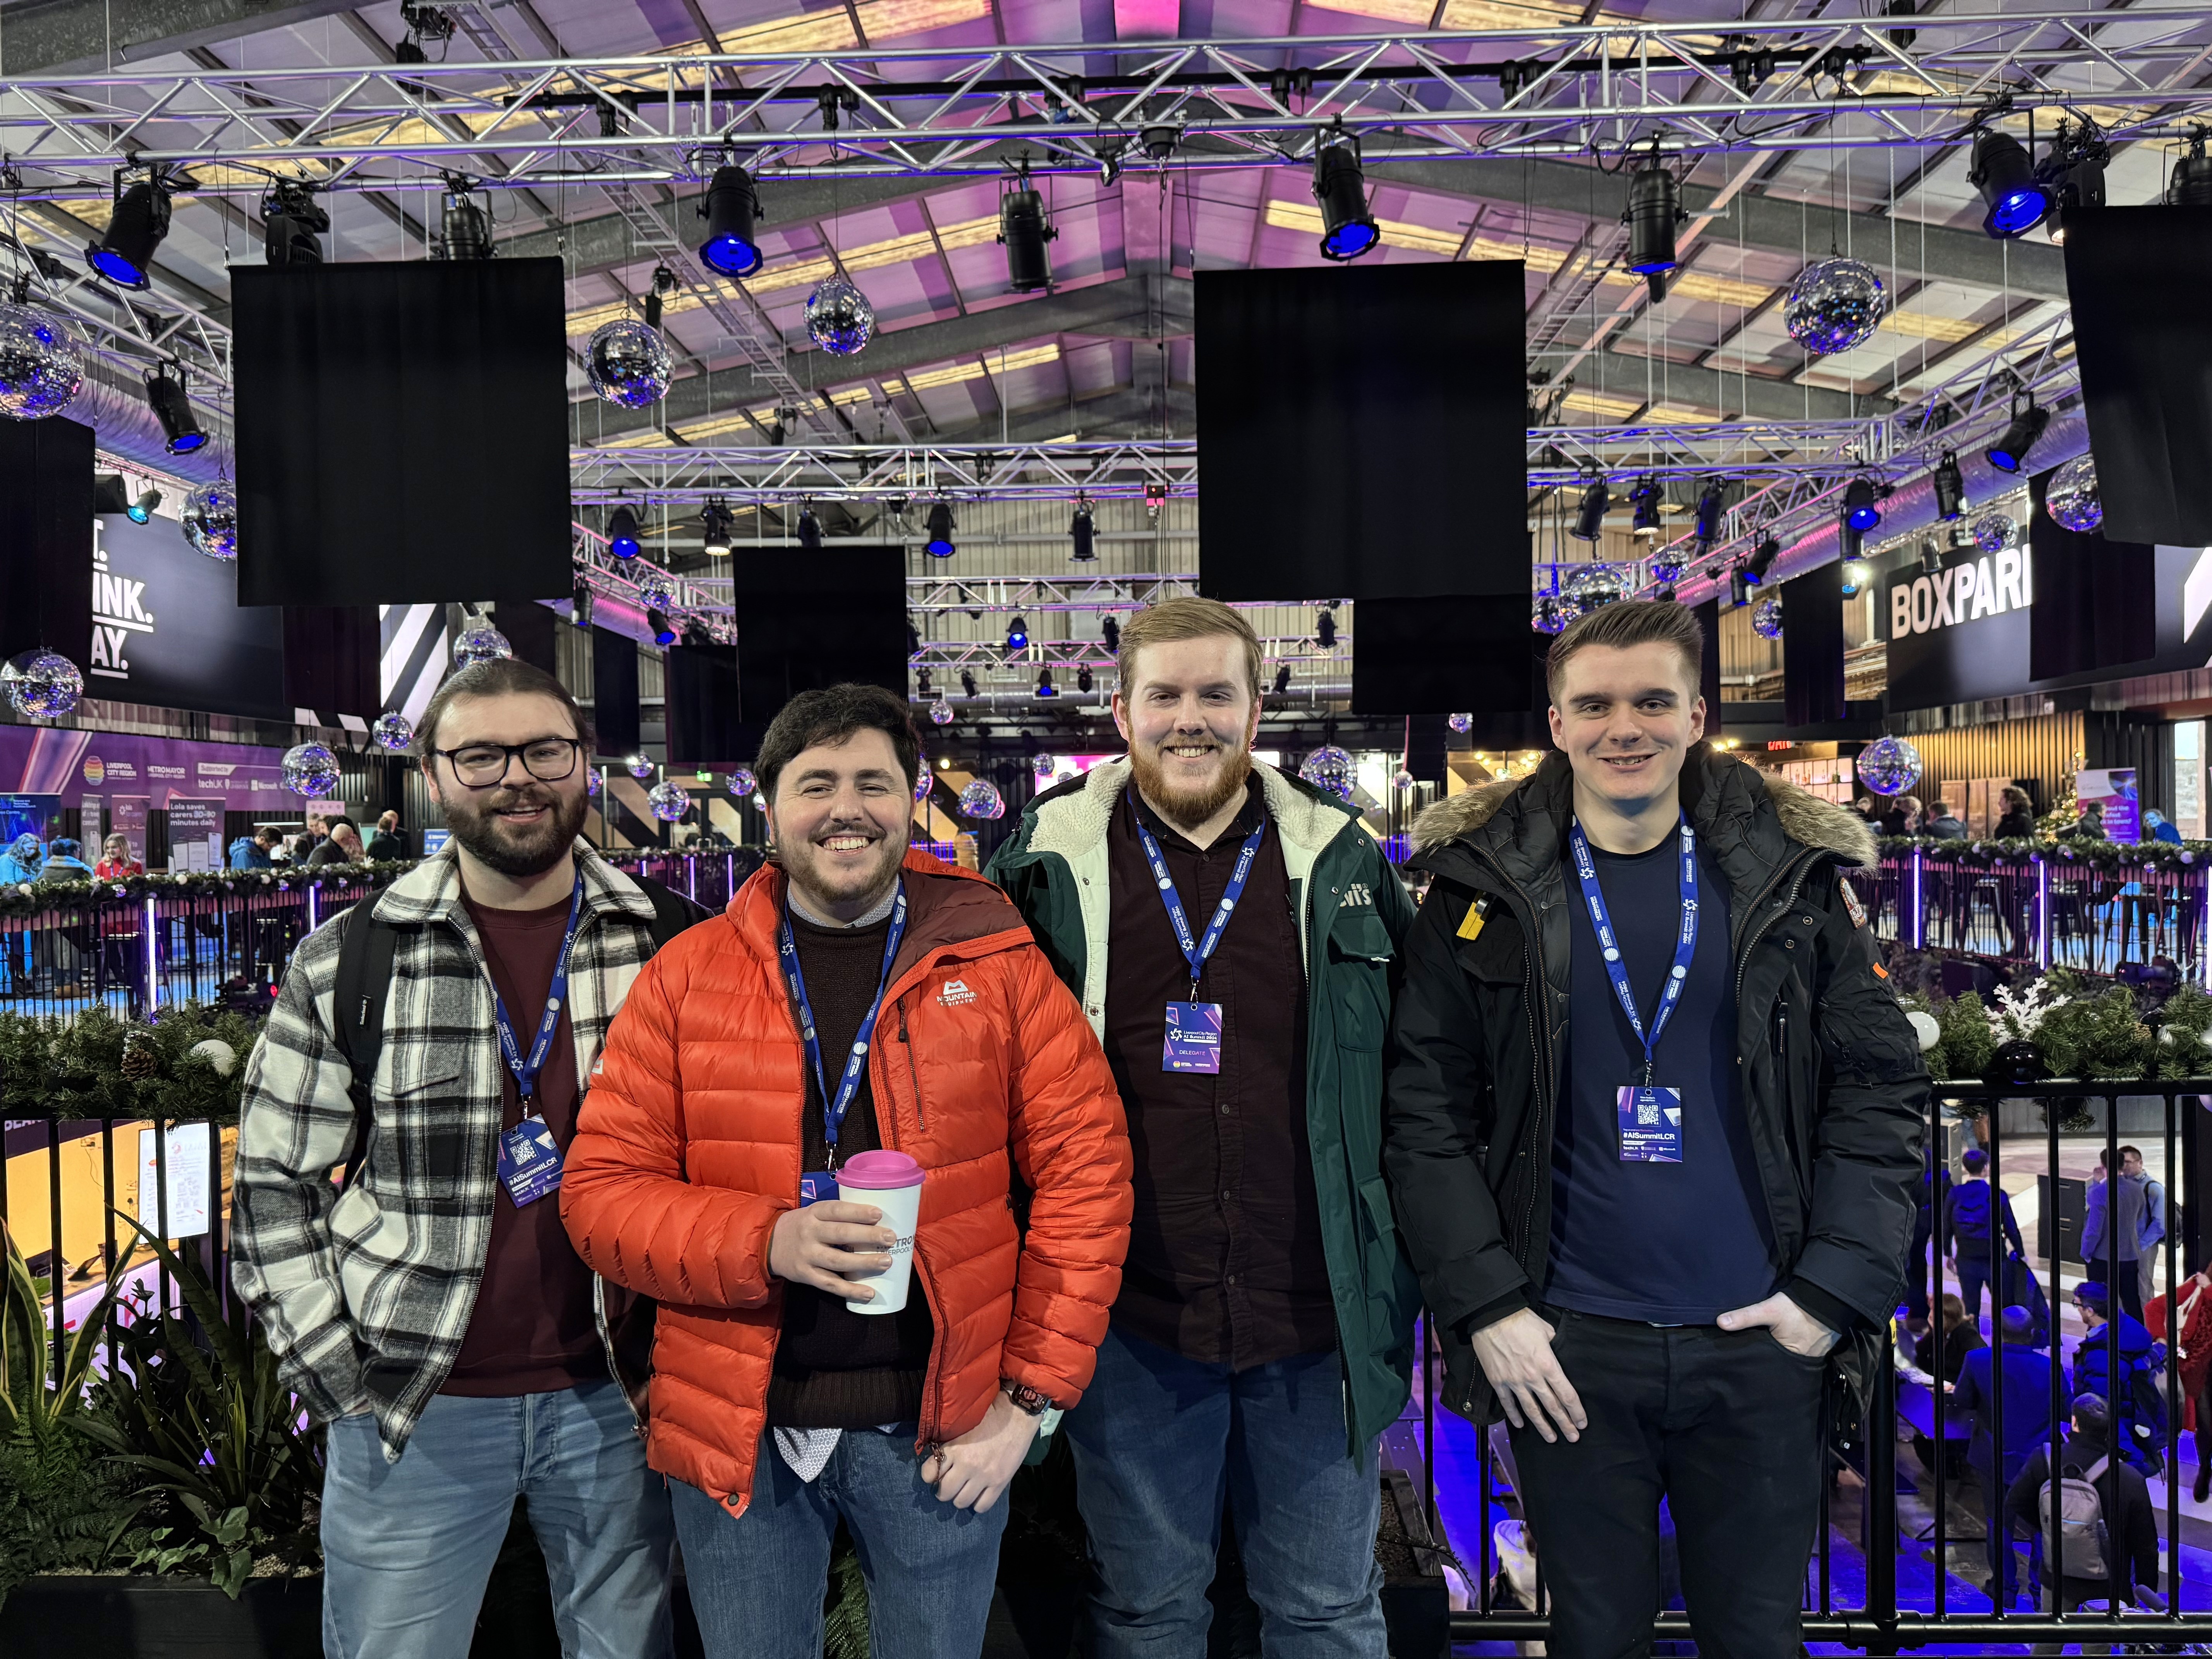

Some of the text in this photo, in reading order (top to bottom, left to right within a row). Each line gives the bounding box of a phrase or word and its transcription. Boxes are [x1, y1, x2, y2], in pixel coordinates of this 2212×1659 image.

[198, 778, 223, 788] techUK
[200, 819, 216, 828] daily
[936, 991, 977, 1002] MOUNTAIN
[509, 1157, 558, 1186] #AISummitLCR
